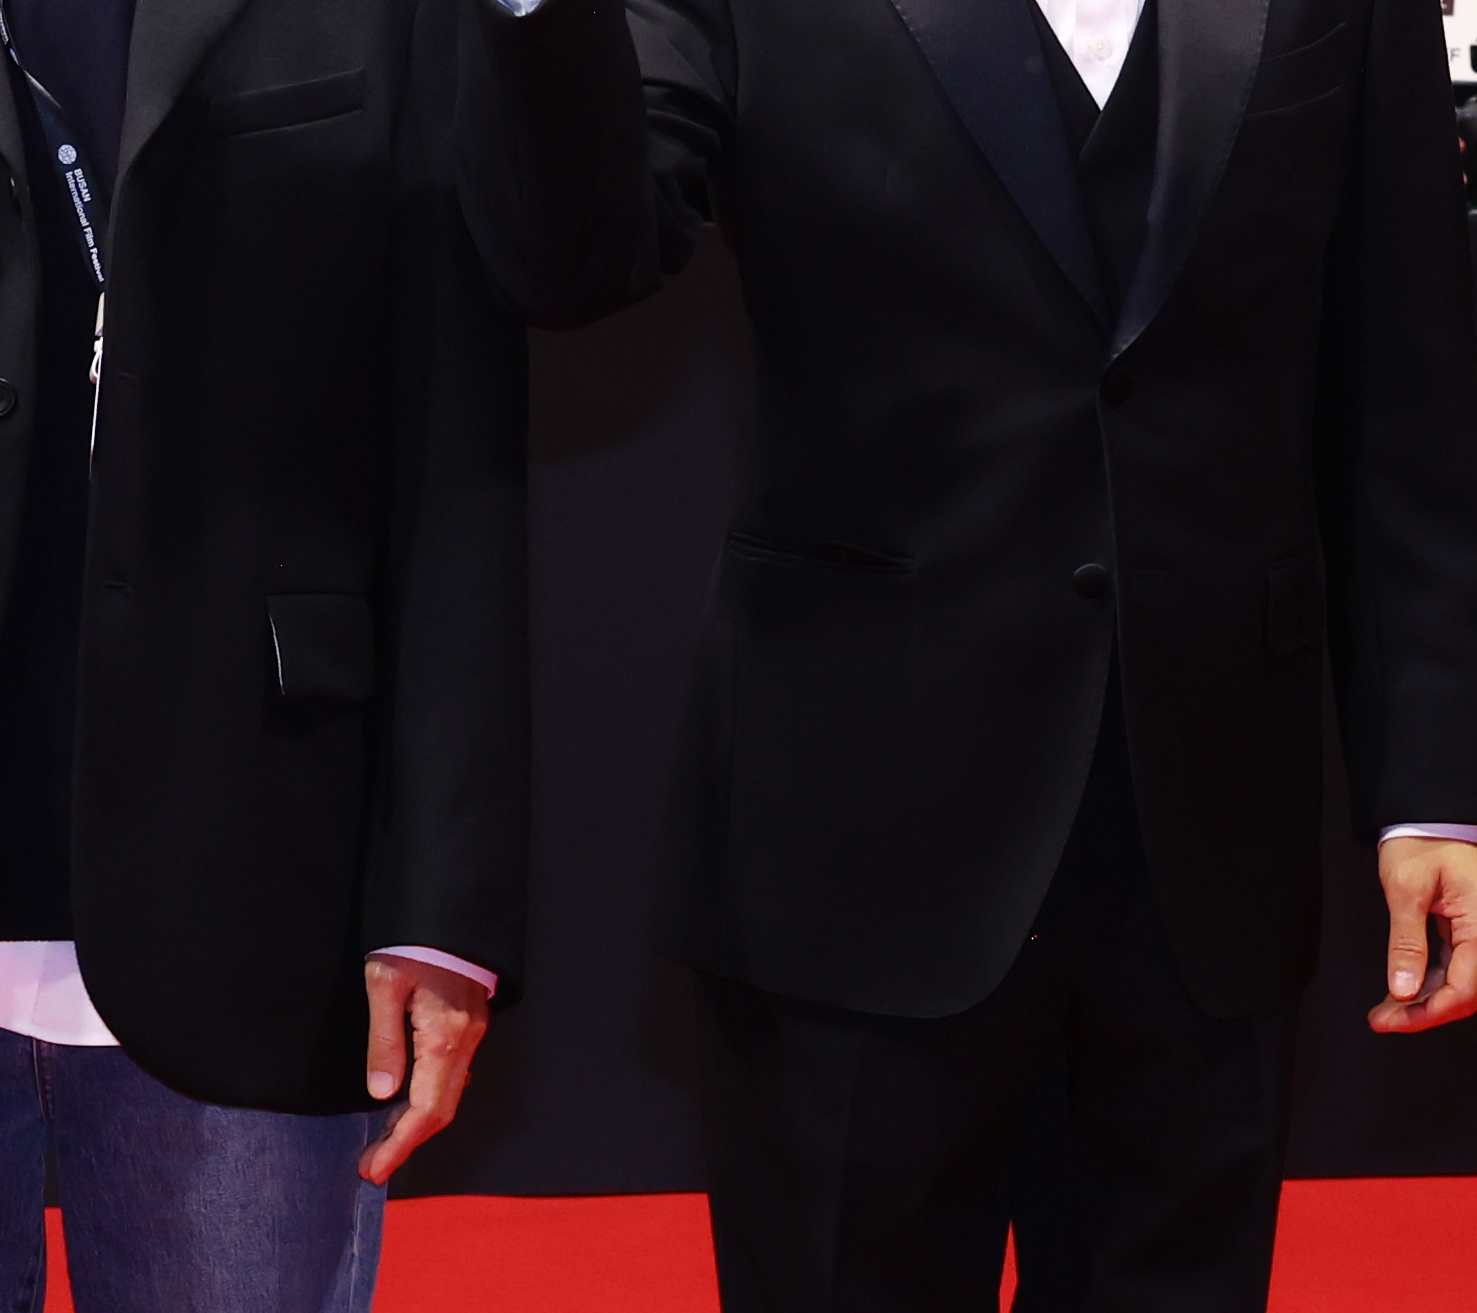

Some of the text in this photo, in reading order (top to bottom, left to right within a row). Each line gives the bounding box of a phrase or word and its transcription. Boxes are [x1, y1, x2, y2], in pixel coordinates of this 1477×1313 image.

[74, 168, 92, 202] BUSAN
[65, 171, 105, 283] International Film Festival
